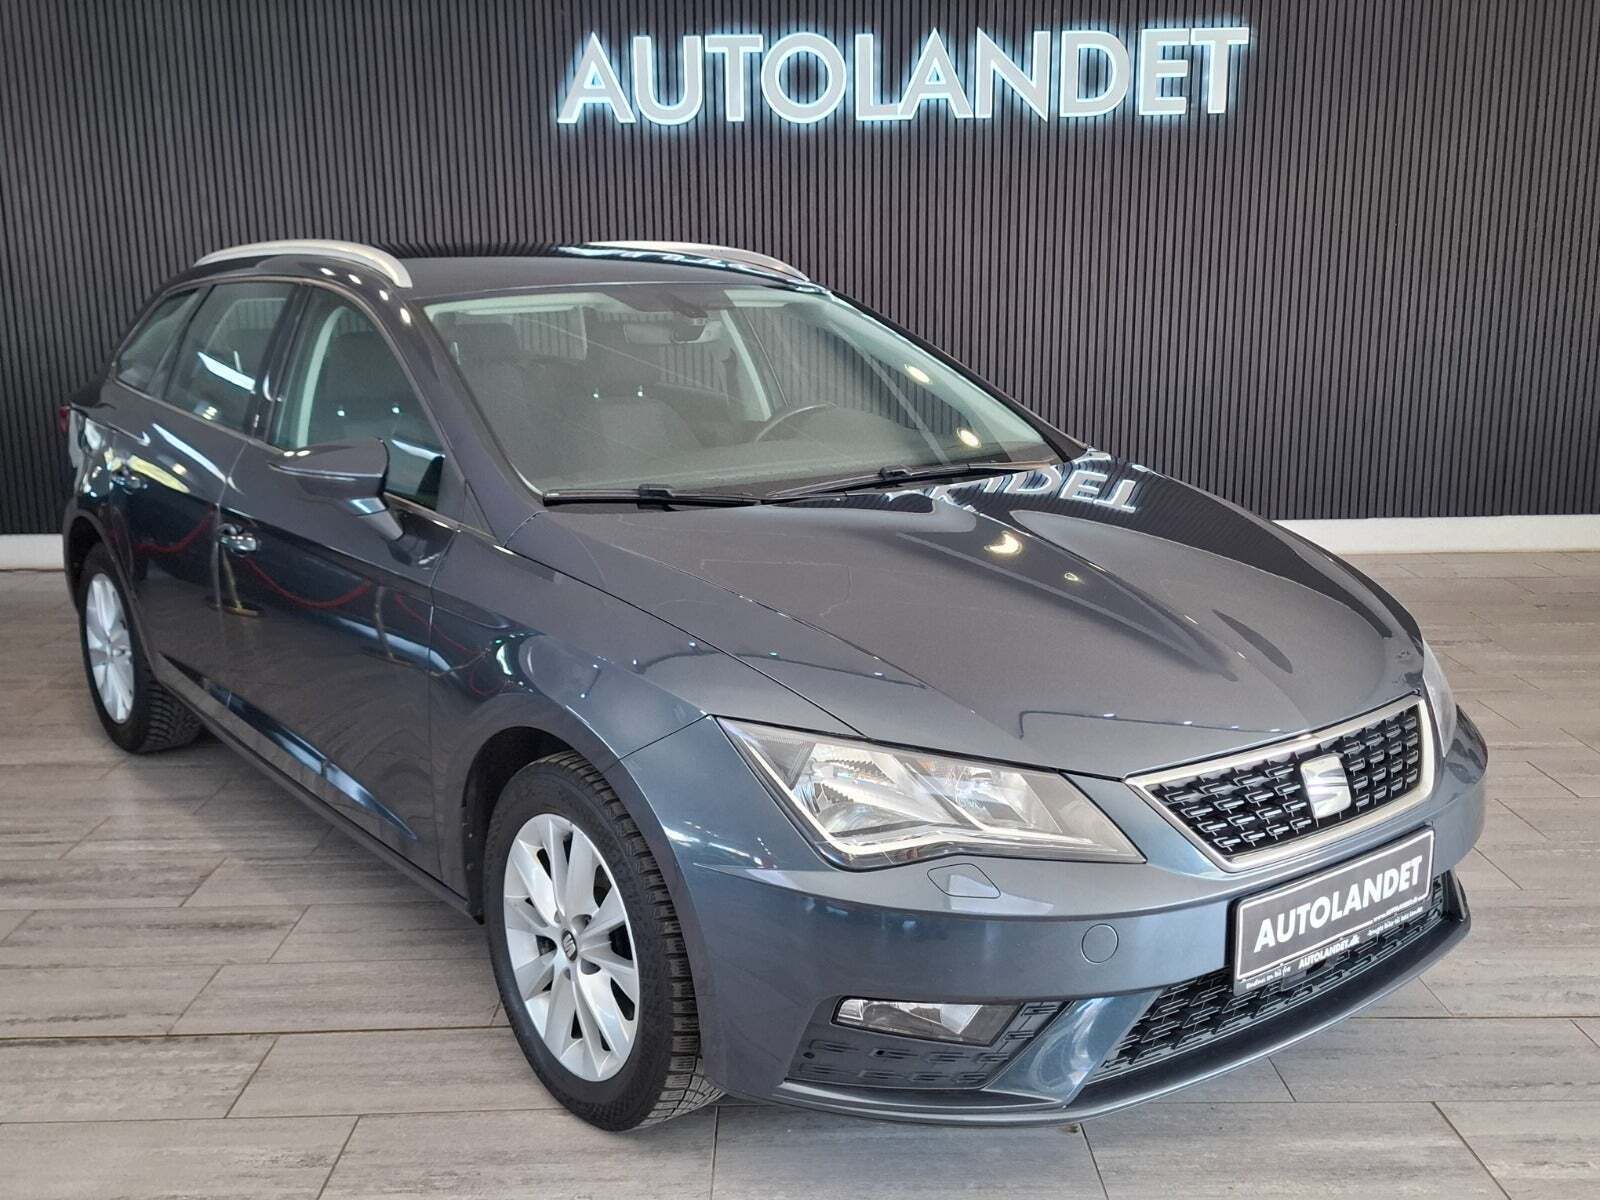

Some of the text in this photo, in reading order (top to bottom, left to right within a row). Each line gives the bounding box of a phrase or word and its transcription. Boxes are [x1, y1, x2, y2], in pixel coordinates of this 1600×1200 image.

[557, 26, 1249, 125] AUTOLANDET
[1254, 855, 1422, 953] AUTOLANDET
[1298, 934, 1360, 969] AUTOLANDET.dk
